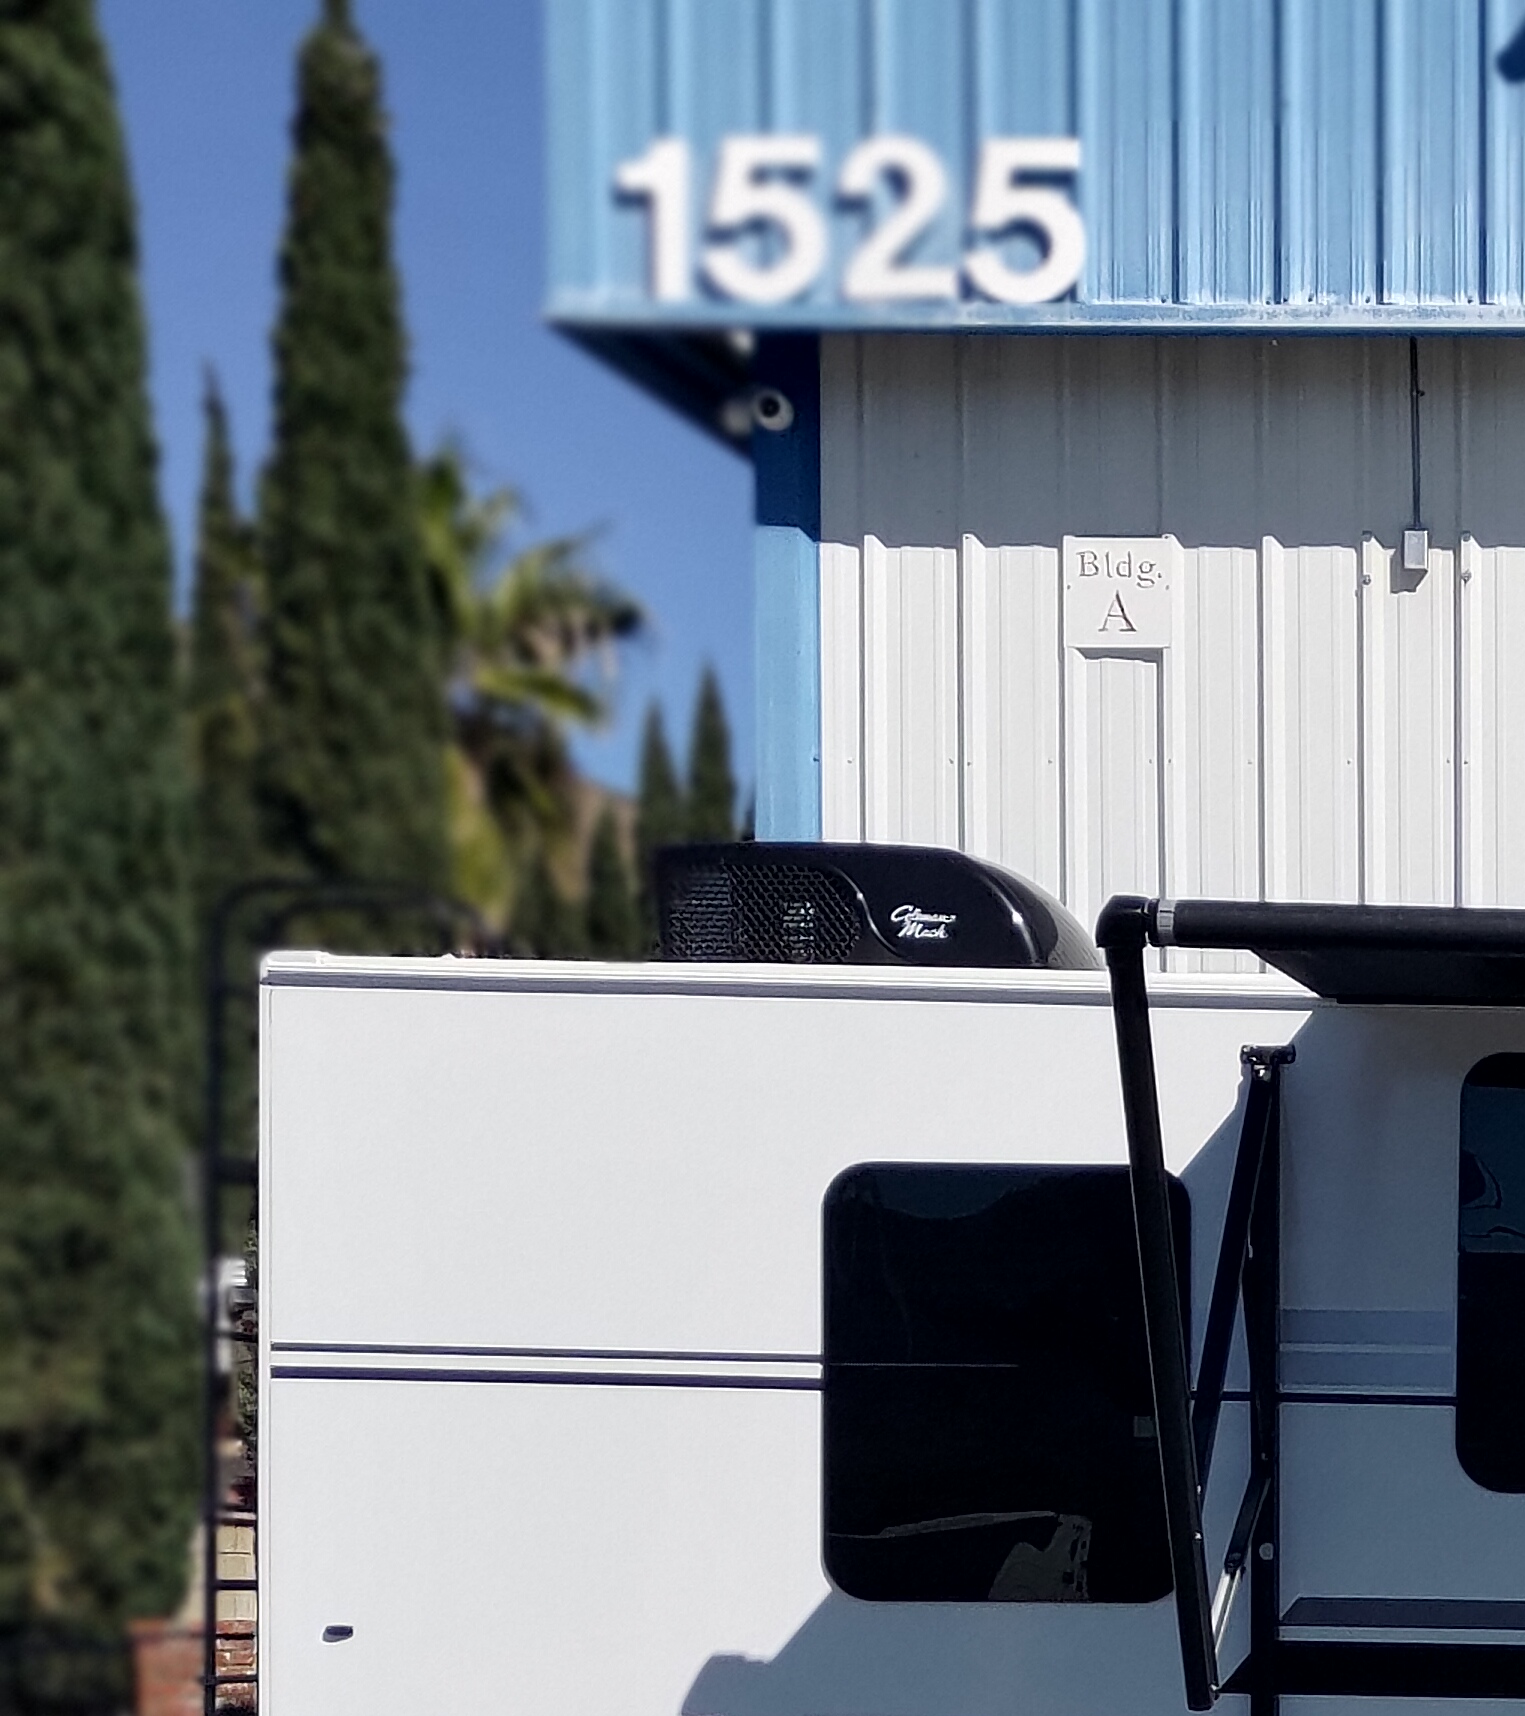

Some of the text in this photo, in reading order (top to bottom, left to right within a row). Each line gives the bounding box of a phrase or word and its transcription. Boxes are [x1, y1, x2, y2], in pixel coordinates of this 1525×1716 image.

[614, 133, 1088, 304] 1525
[1075, 550, 1163, 589] Bldg.
[1098, 589, 1137, 632] A
